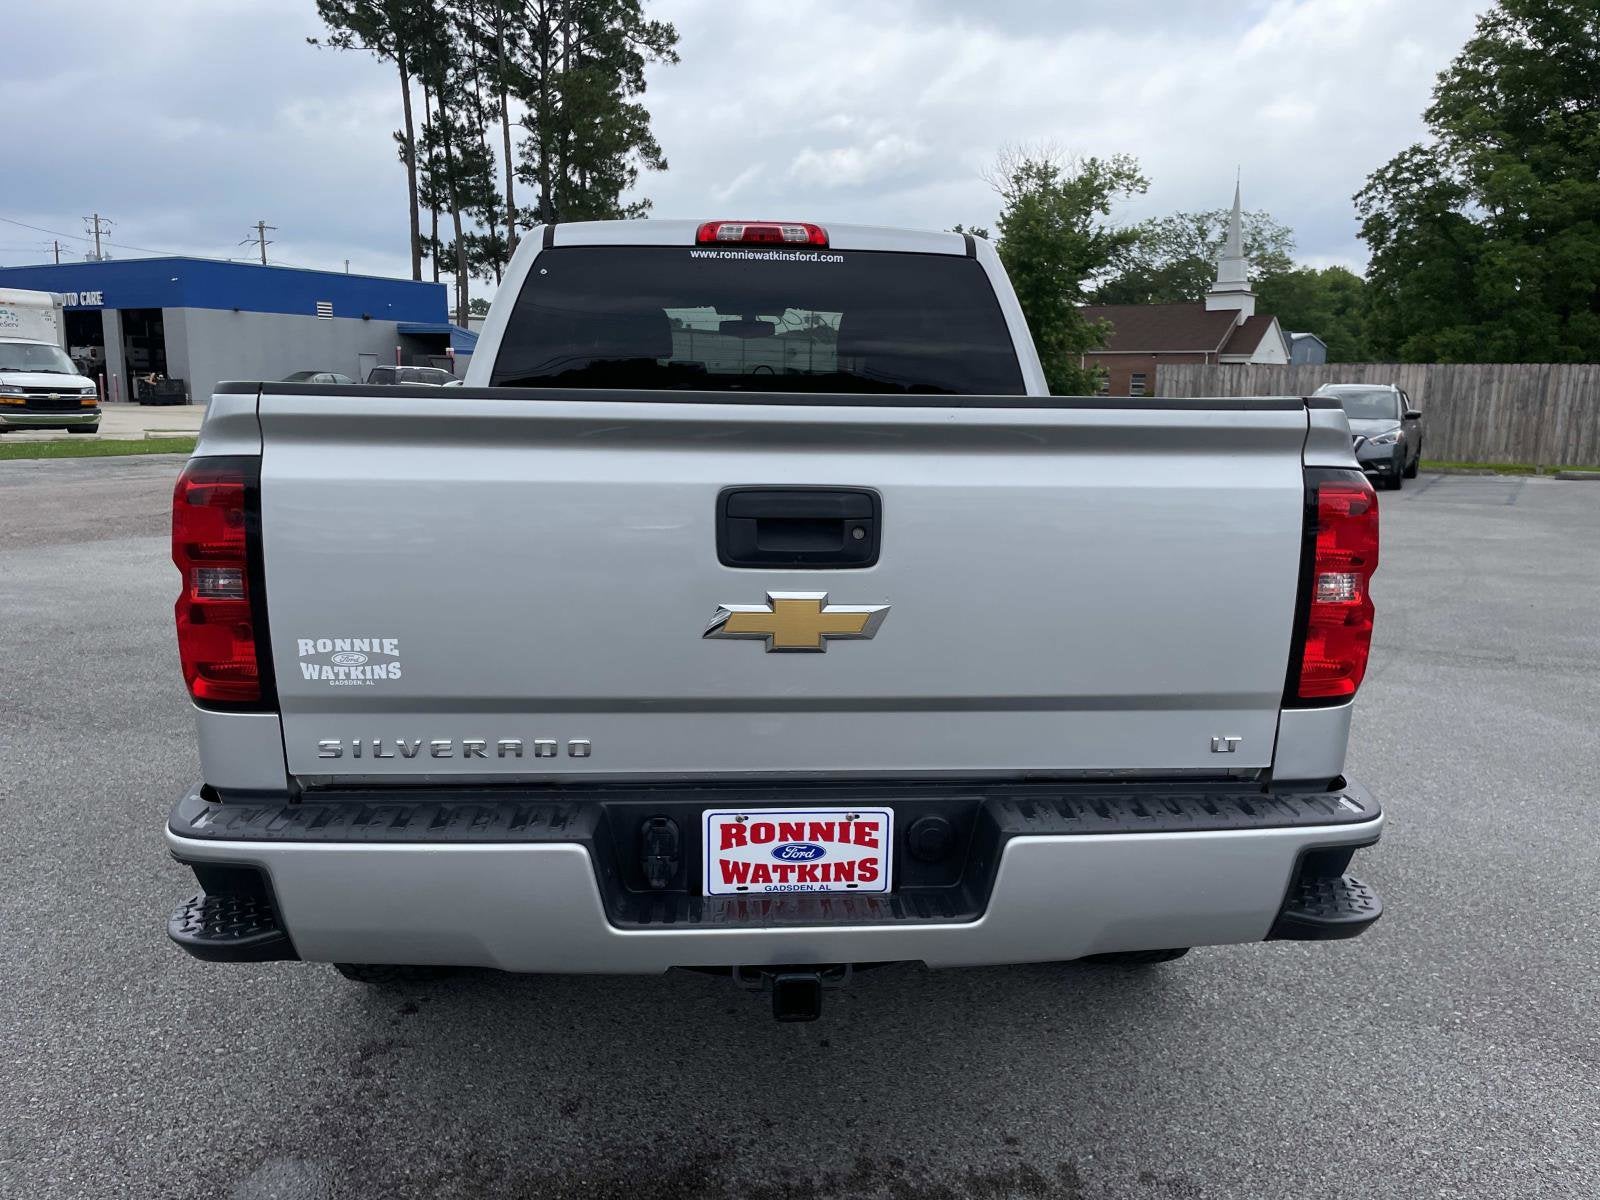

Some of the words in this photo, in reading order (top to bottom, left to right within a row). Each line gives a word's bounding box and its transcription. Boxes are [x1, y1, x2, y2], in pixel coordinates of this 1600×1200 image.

[690, 250, 844, 263] www.ronniewatkinsford.com
[63, 293, 79, 306] UTO
[80, 291, 104, 306] CARE
[297, 638, 399, 657] RONNIE
[299, 661, 402, 680] WATKINS
[318, 738, 592, 759] SILVERADO
[1211, 736, 1242, 754] LT
[719, 821, 879, 851] RONNIE
[781, 846, 816, 859] Ford
[719, 857, 879, 885] WATKINS
[764, 884, 817, 892] GADSDEN,
